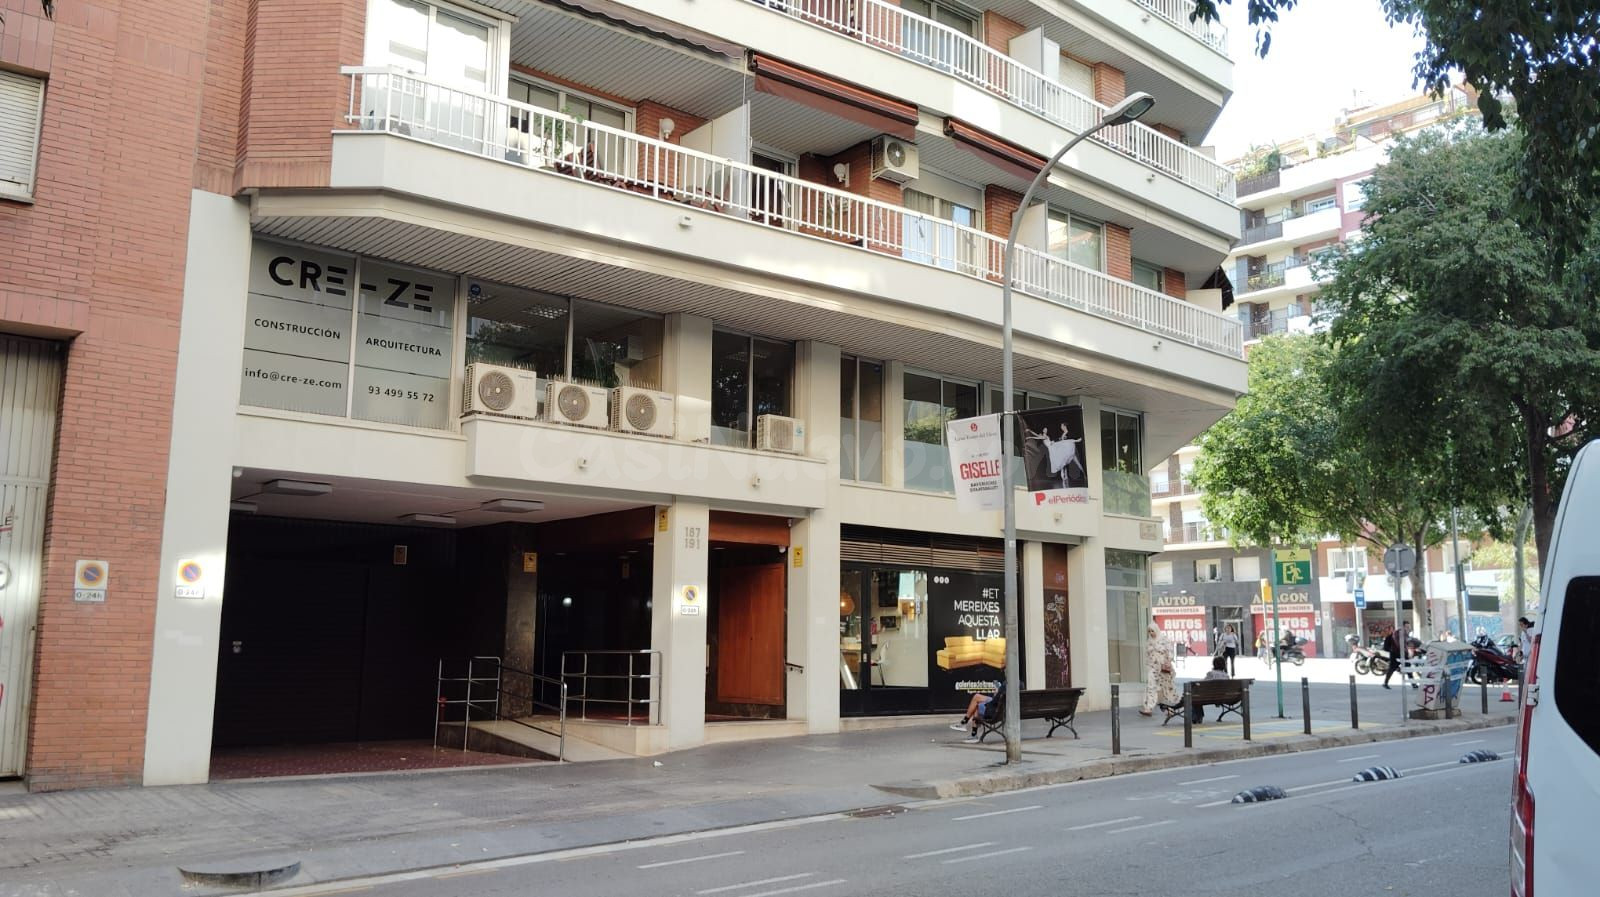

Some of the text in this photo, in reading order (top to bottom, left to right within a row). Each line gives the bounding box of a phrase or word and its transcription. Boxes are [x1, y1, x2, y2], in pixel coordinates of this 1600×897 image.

[254, 318, 341, 340] CONSTRUCCIÓN
[365, 337, 442, 357] ARQUITECTURA
[244, 367, 342, 389] info@cre-ze.com
[368, 385, 434, 402] 93 499 55 72
[959, 459, 1000, 480] GISELLE
[684, 526, 701, 538] 187
[982, 588, 999, 599] #ET
[1157, 592, 1309, 606] AUTOS AGON
[954, 600, 1000, 613] MEREIXES
[958, 614, 1000, 627] AQUESTA
[1164, 619, 1203, 630] AUTOS
[1266, 617, 1309, 629] ATOS
[976, 628, 1000, 640] LLAR
